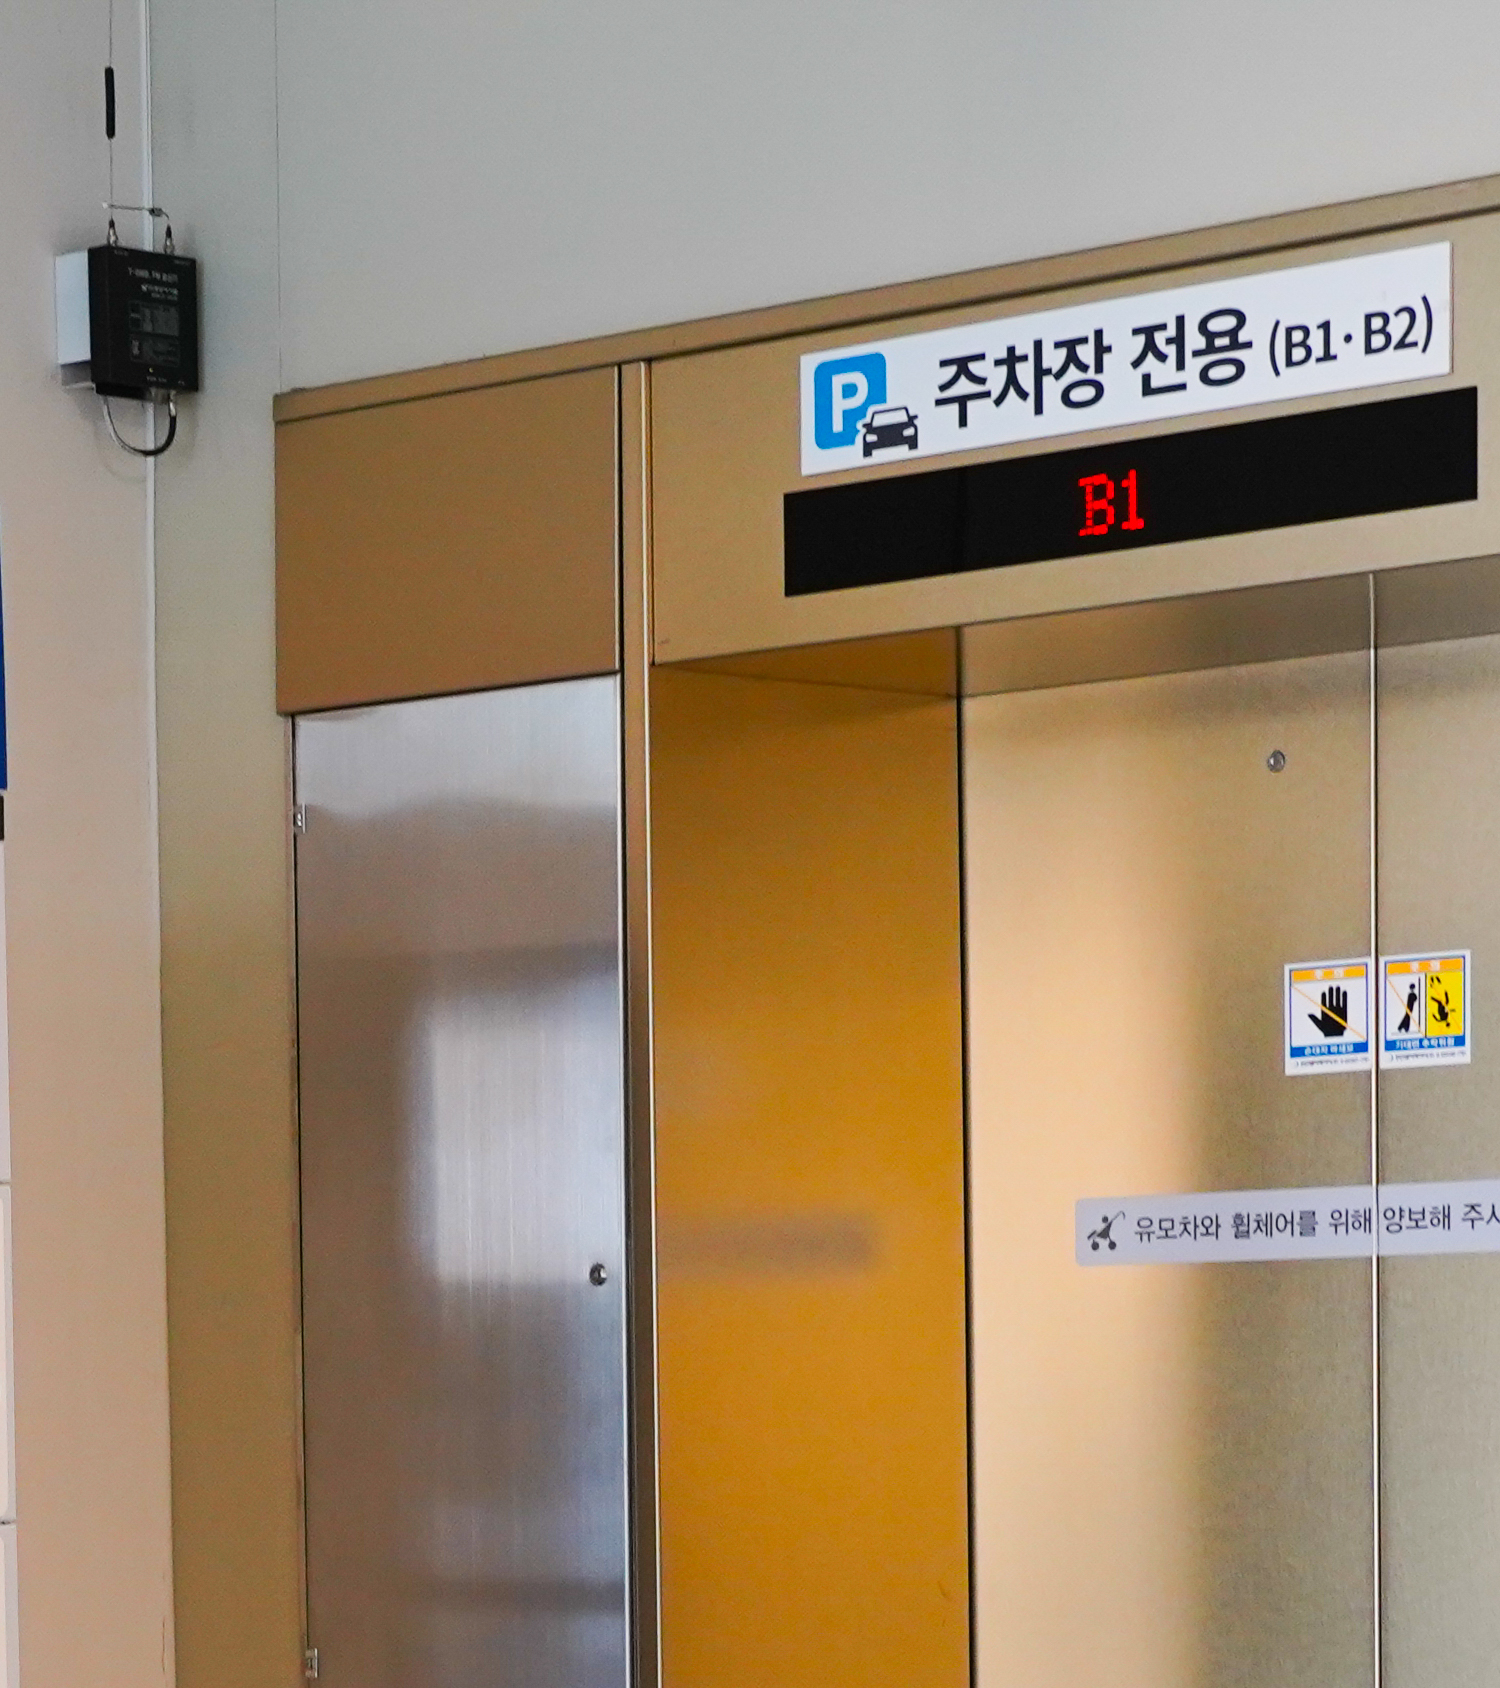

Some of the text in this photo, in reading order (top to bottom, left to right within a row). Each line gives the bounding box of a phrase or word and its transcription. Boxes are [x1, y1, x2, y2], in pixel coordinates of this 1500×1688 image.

[934, 295, 1435, 430] 주차장 전용 (B1·B2)
[1078, 470, 1145, 537] B1
[1135, 1213, 1221, 1244] 유모차와
[1231, 1209, 1318, 1239] 휠체어를
[1328, 1207, 1372, 1236] 위해
[1382, 1205, 1451, 1235] 양보해
